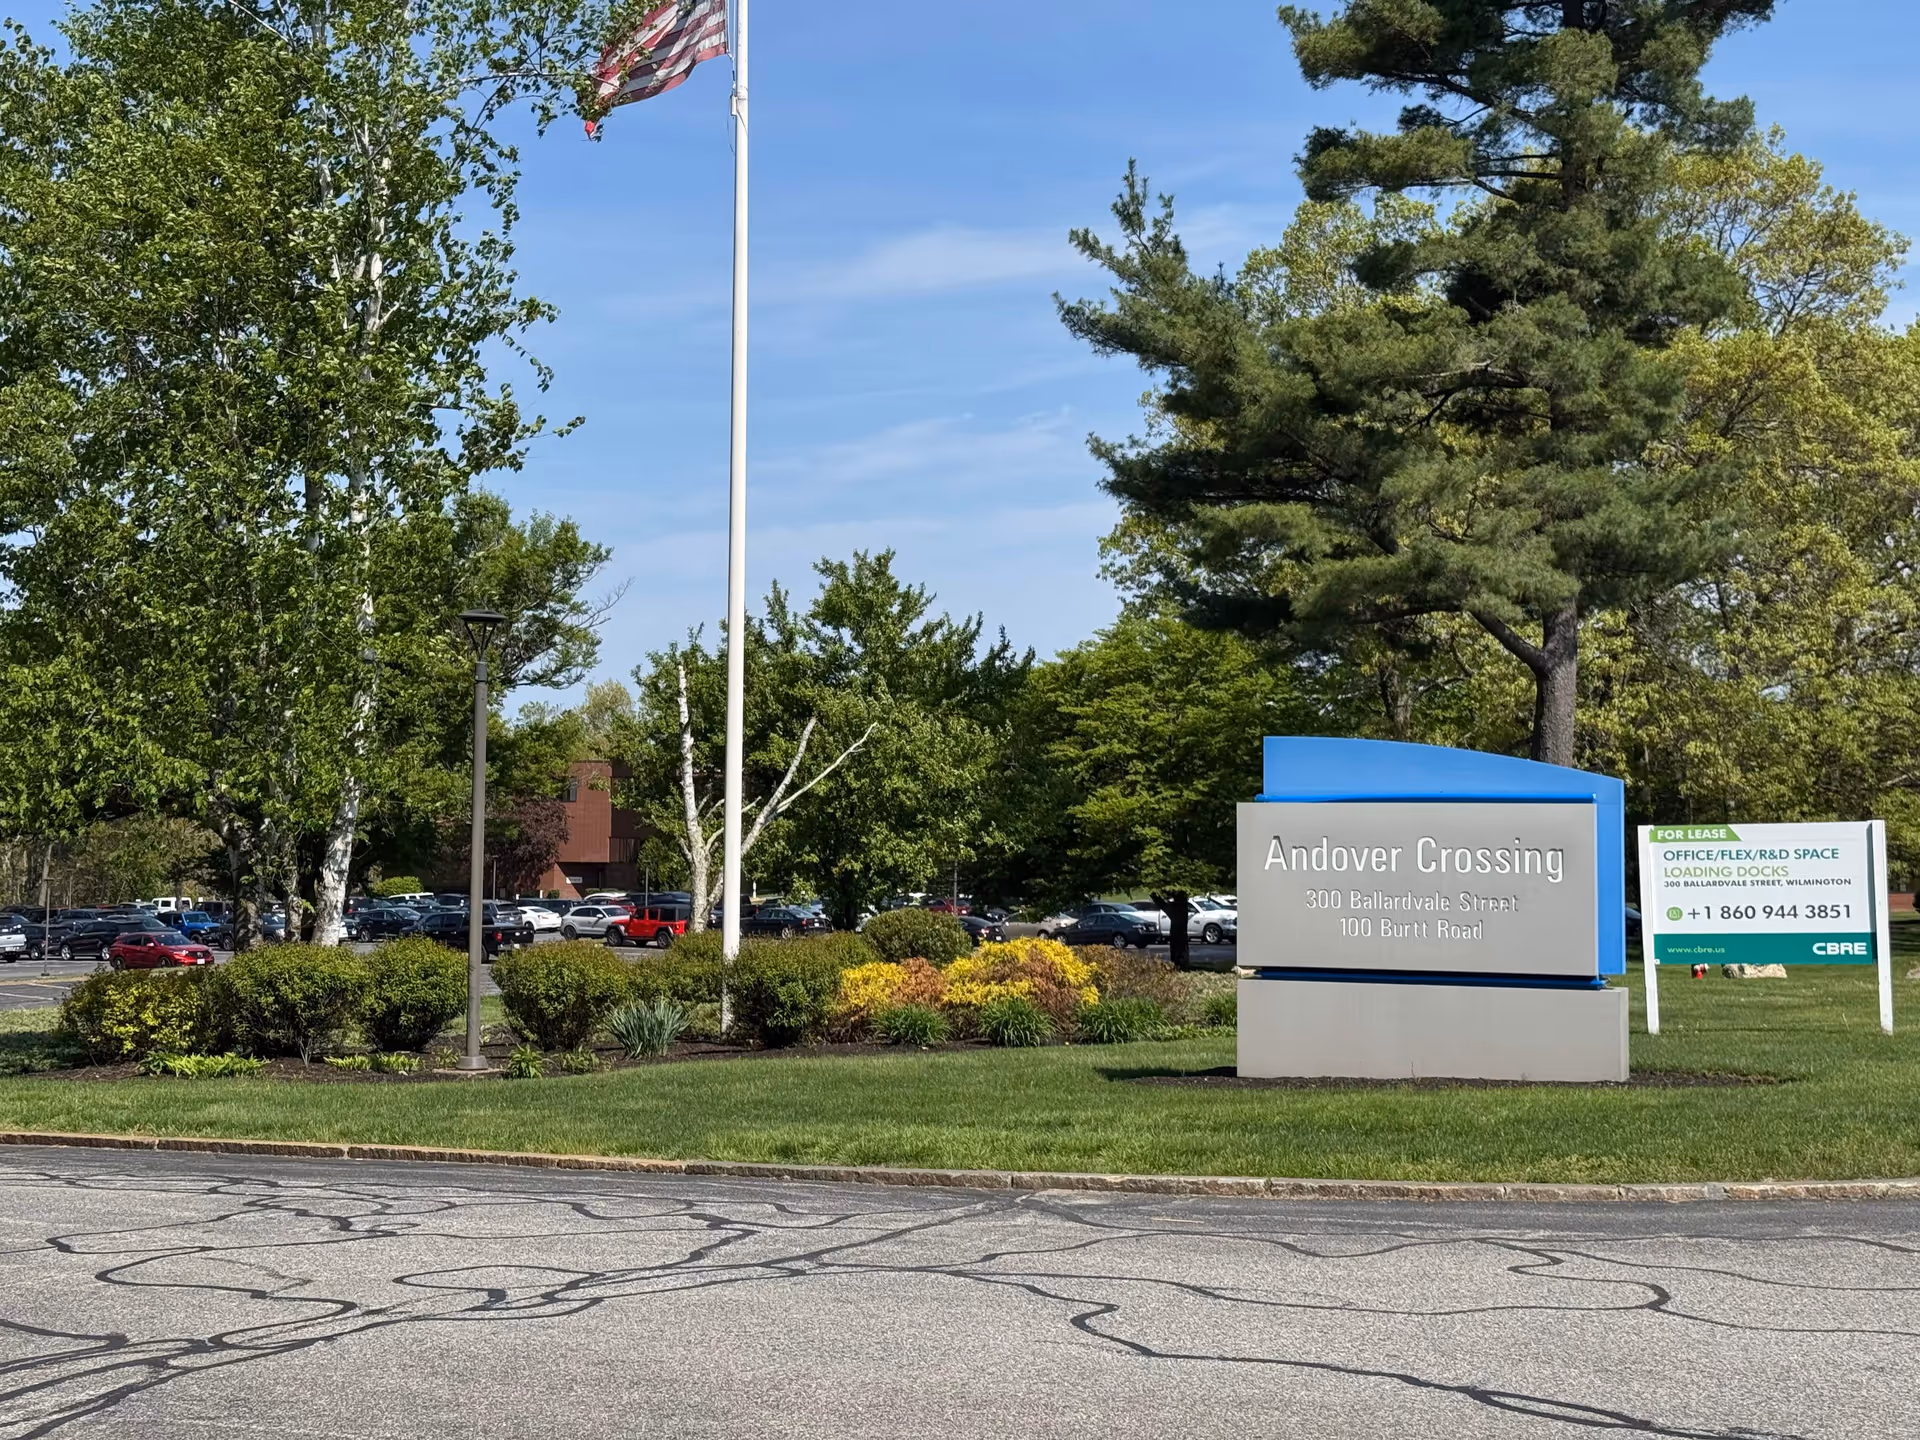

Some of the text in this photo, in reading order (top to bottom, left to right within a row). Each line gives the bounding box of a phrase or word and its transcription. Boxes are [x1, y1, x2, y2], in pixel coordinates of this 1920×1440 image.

[1657, 829, 1727, 840] FOR LEASE
[1264, 835, 1564, 884] Andover Crossing
[1663, 848, 1840, 862] OFFICE/FLEX/R&D SPACE
[1664, 865, 1789, 878] LOADING DOCKS
[1664, 878, 1852, 888] 300 BALLARDVALE STREET, WILMINGTON
[1305, 888, 1519, 912] 300 Ballardvale Street
[1720, 905, 1756, 920] 860
[1762, 904, 1798, 919] 944
[1804, 904, 1850, 919] 3851
[1339, 916, 1484, 940] 100 Burtt Road
[1666, 945, 1726, 953] www.cbre.us
[1812, 942, 1868, 955] CBRE
